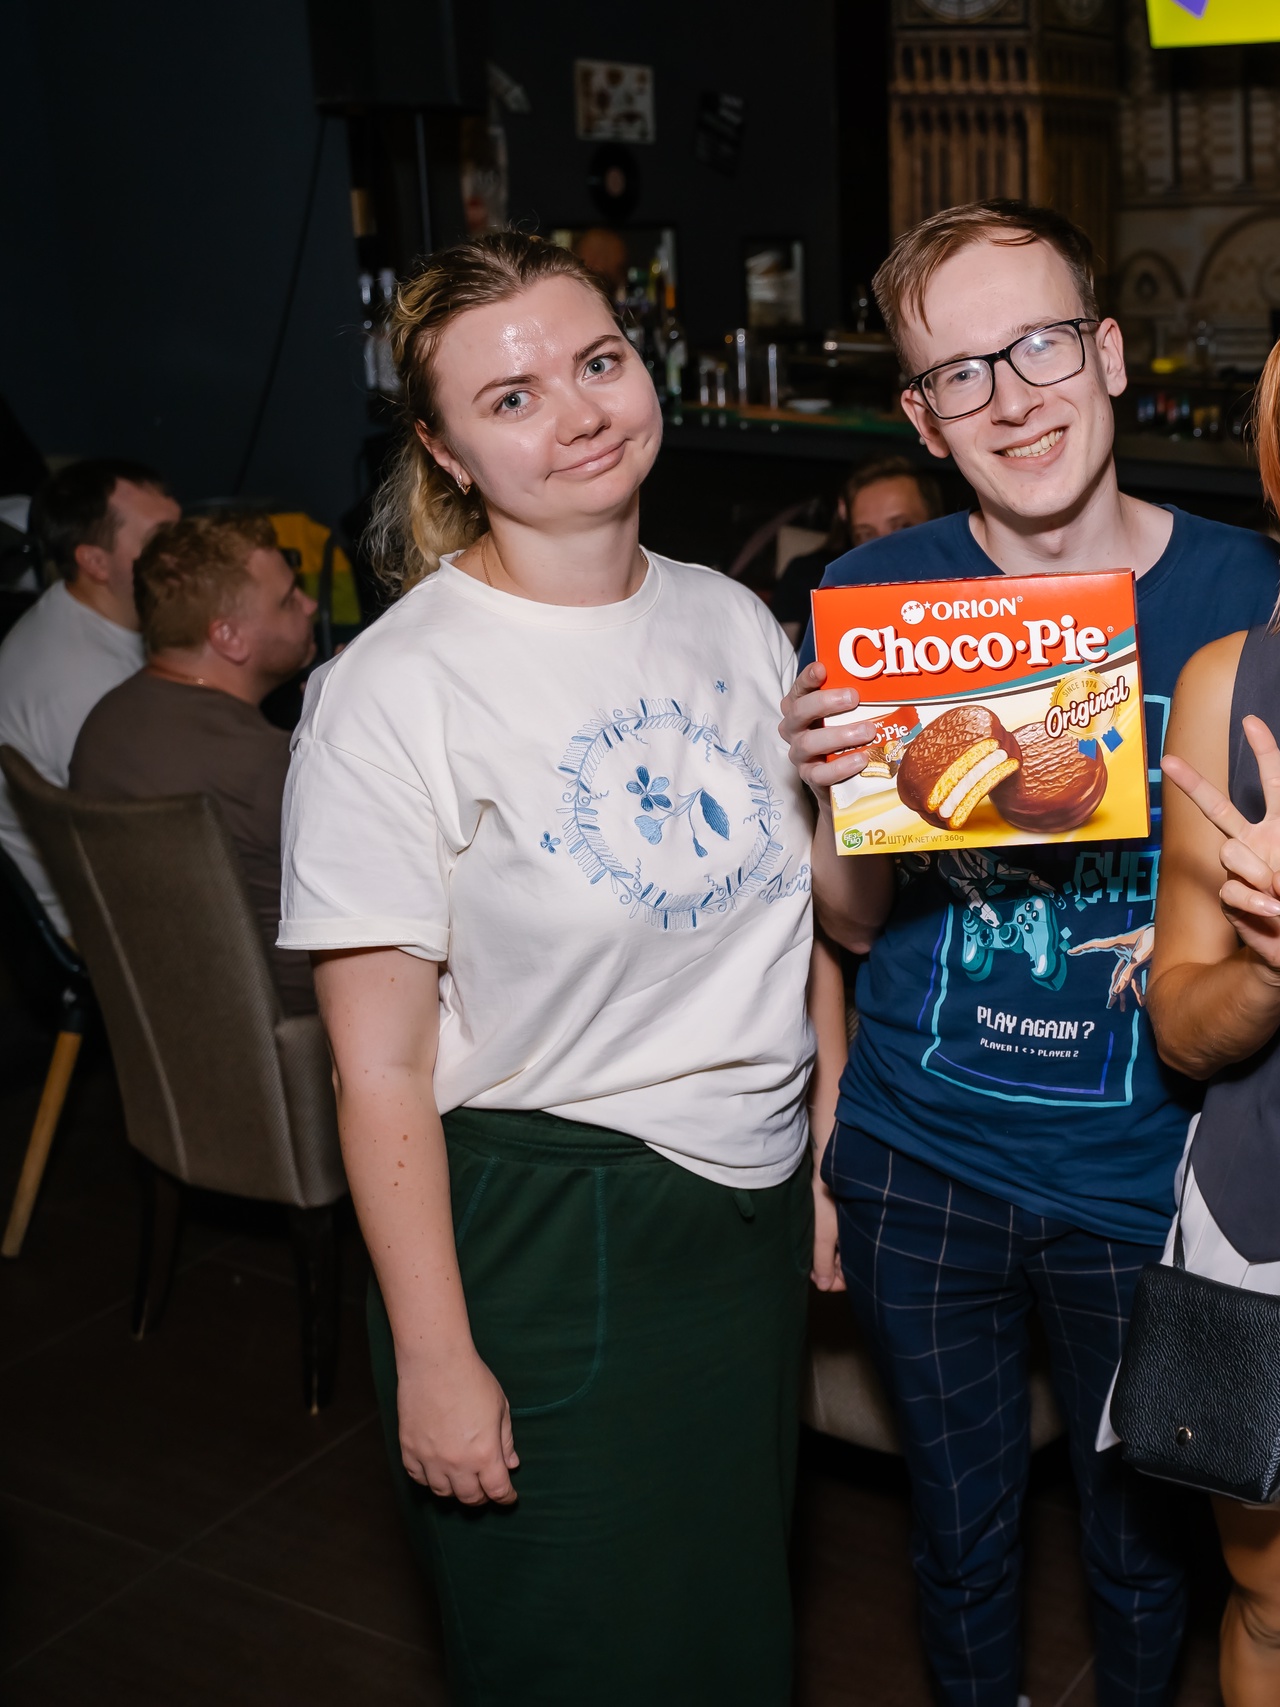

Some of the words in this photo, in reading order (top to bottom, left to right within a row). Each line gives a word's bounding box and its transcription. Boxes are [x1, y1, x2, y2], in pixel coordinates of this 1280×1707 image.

[931, 597, 1017, 621] ORION
[1061, 681, 1080, 698] SINCE
[1081, 680, 1098, 689] 1974
[1045, 675, 1130, 739] Original
[865, 829, 887, 846] 12
[915, 836, 930, 844] NET
[931, 835, 943, 843] WT
[944, 834, 965, 843] 360g
[977, 1005, 1018, 1035] PLAY
[1020, 1018, 1079, 1040] AGAIN
[980, 1037, 1012, 1053] PLAYER
[1037, 1049, 1071, 1058] PLAYER
[1072, 1050, 1080, 1058] 2
